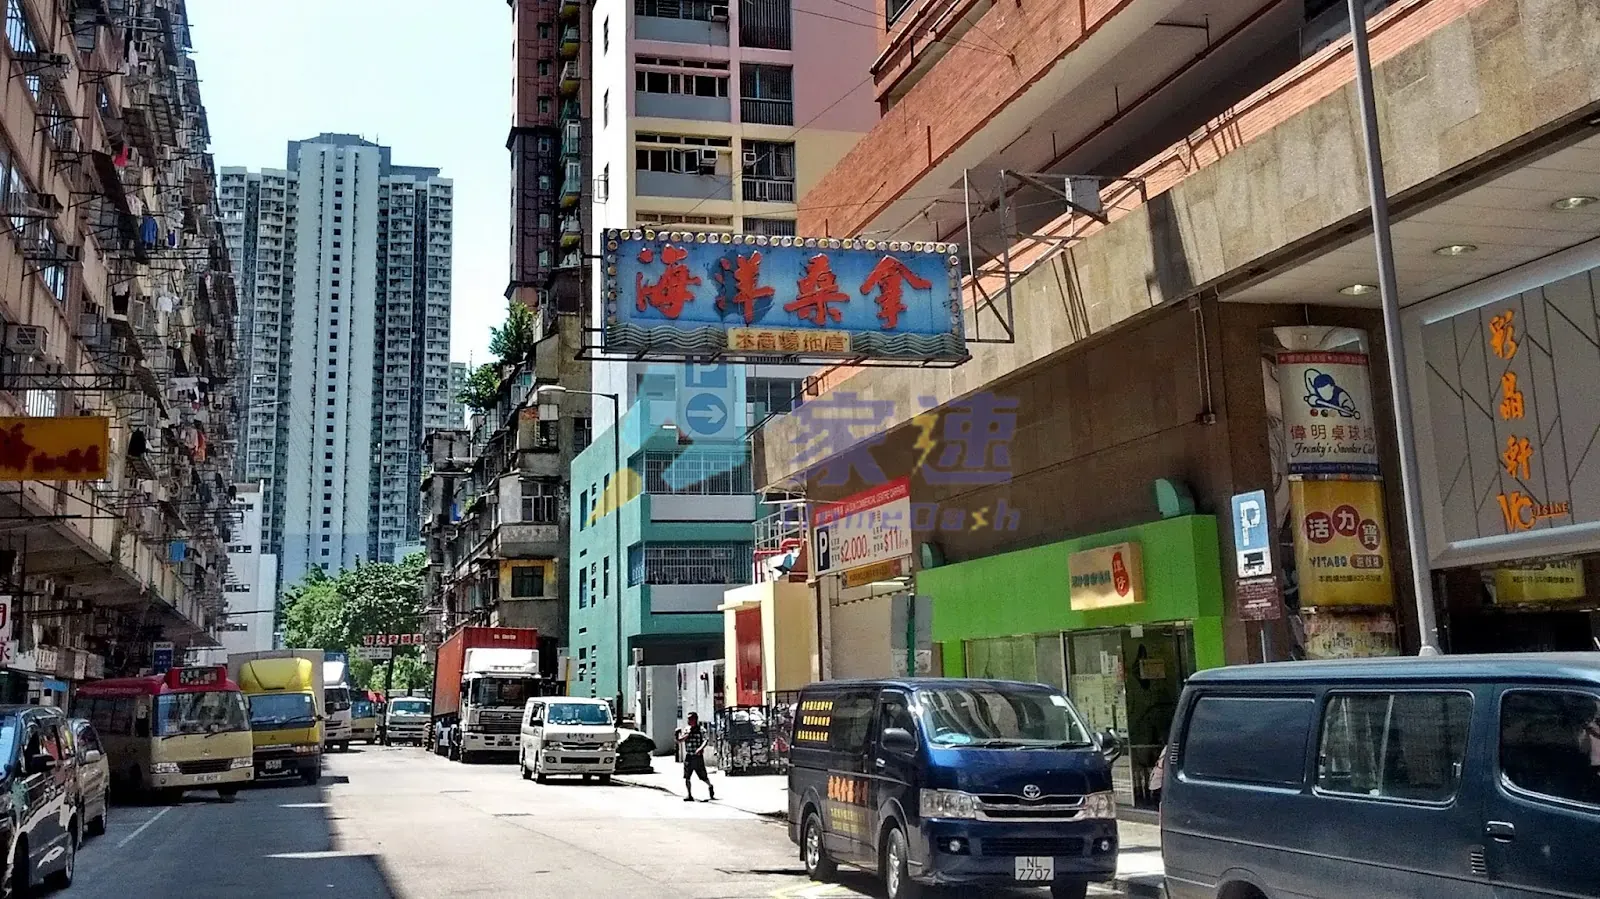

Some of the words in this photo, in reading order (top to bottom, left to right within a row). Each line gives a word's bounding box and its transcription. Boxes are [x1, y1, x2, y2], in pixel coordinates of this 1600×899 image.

[635, 244, 932, 330] 海洋桑拿
[1240, 500, 1261, 547] P
[1308, 509, 1379, 546] 活力寶
[819, 530, 829, 567] P
[1309, 555, 1348, 568] VITABO
[1017, 868, 1051, 881] 7707
[1026, 857, 1042, 869] NL
